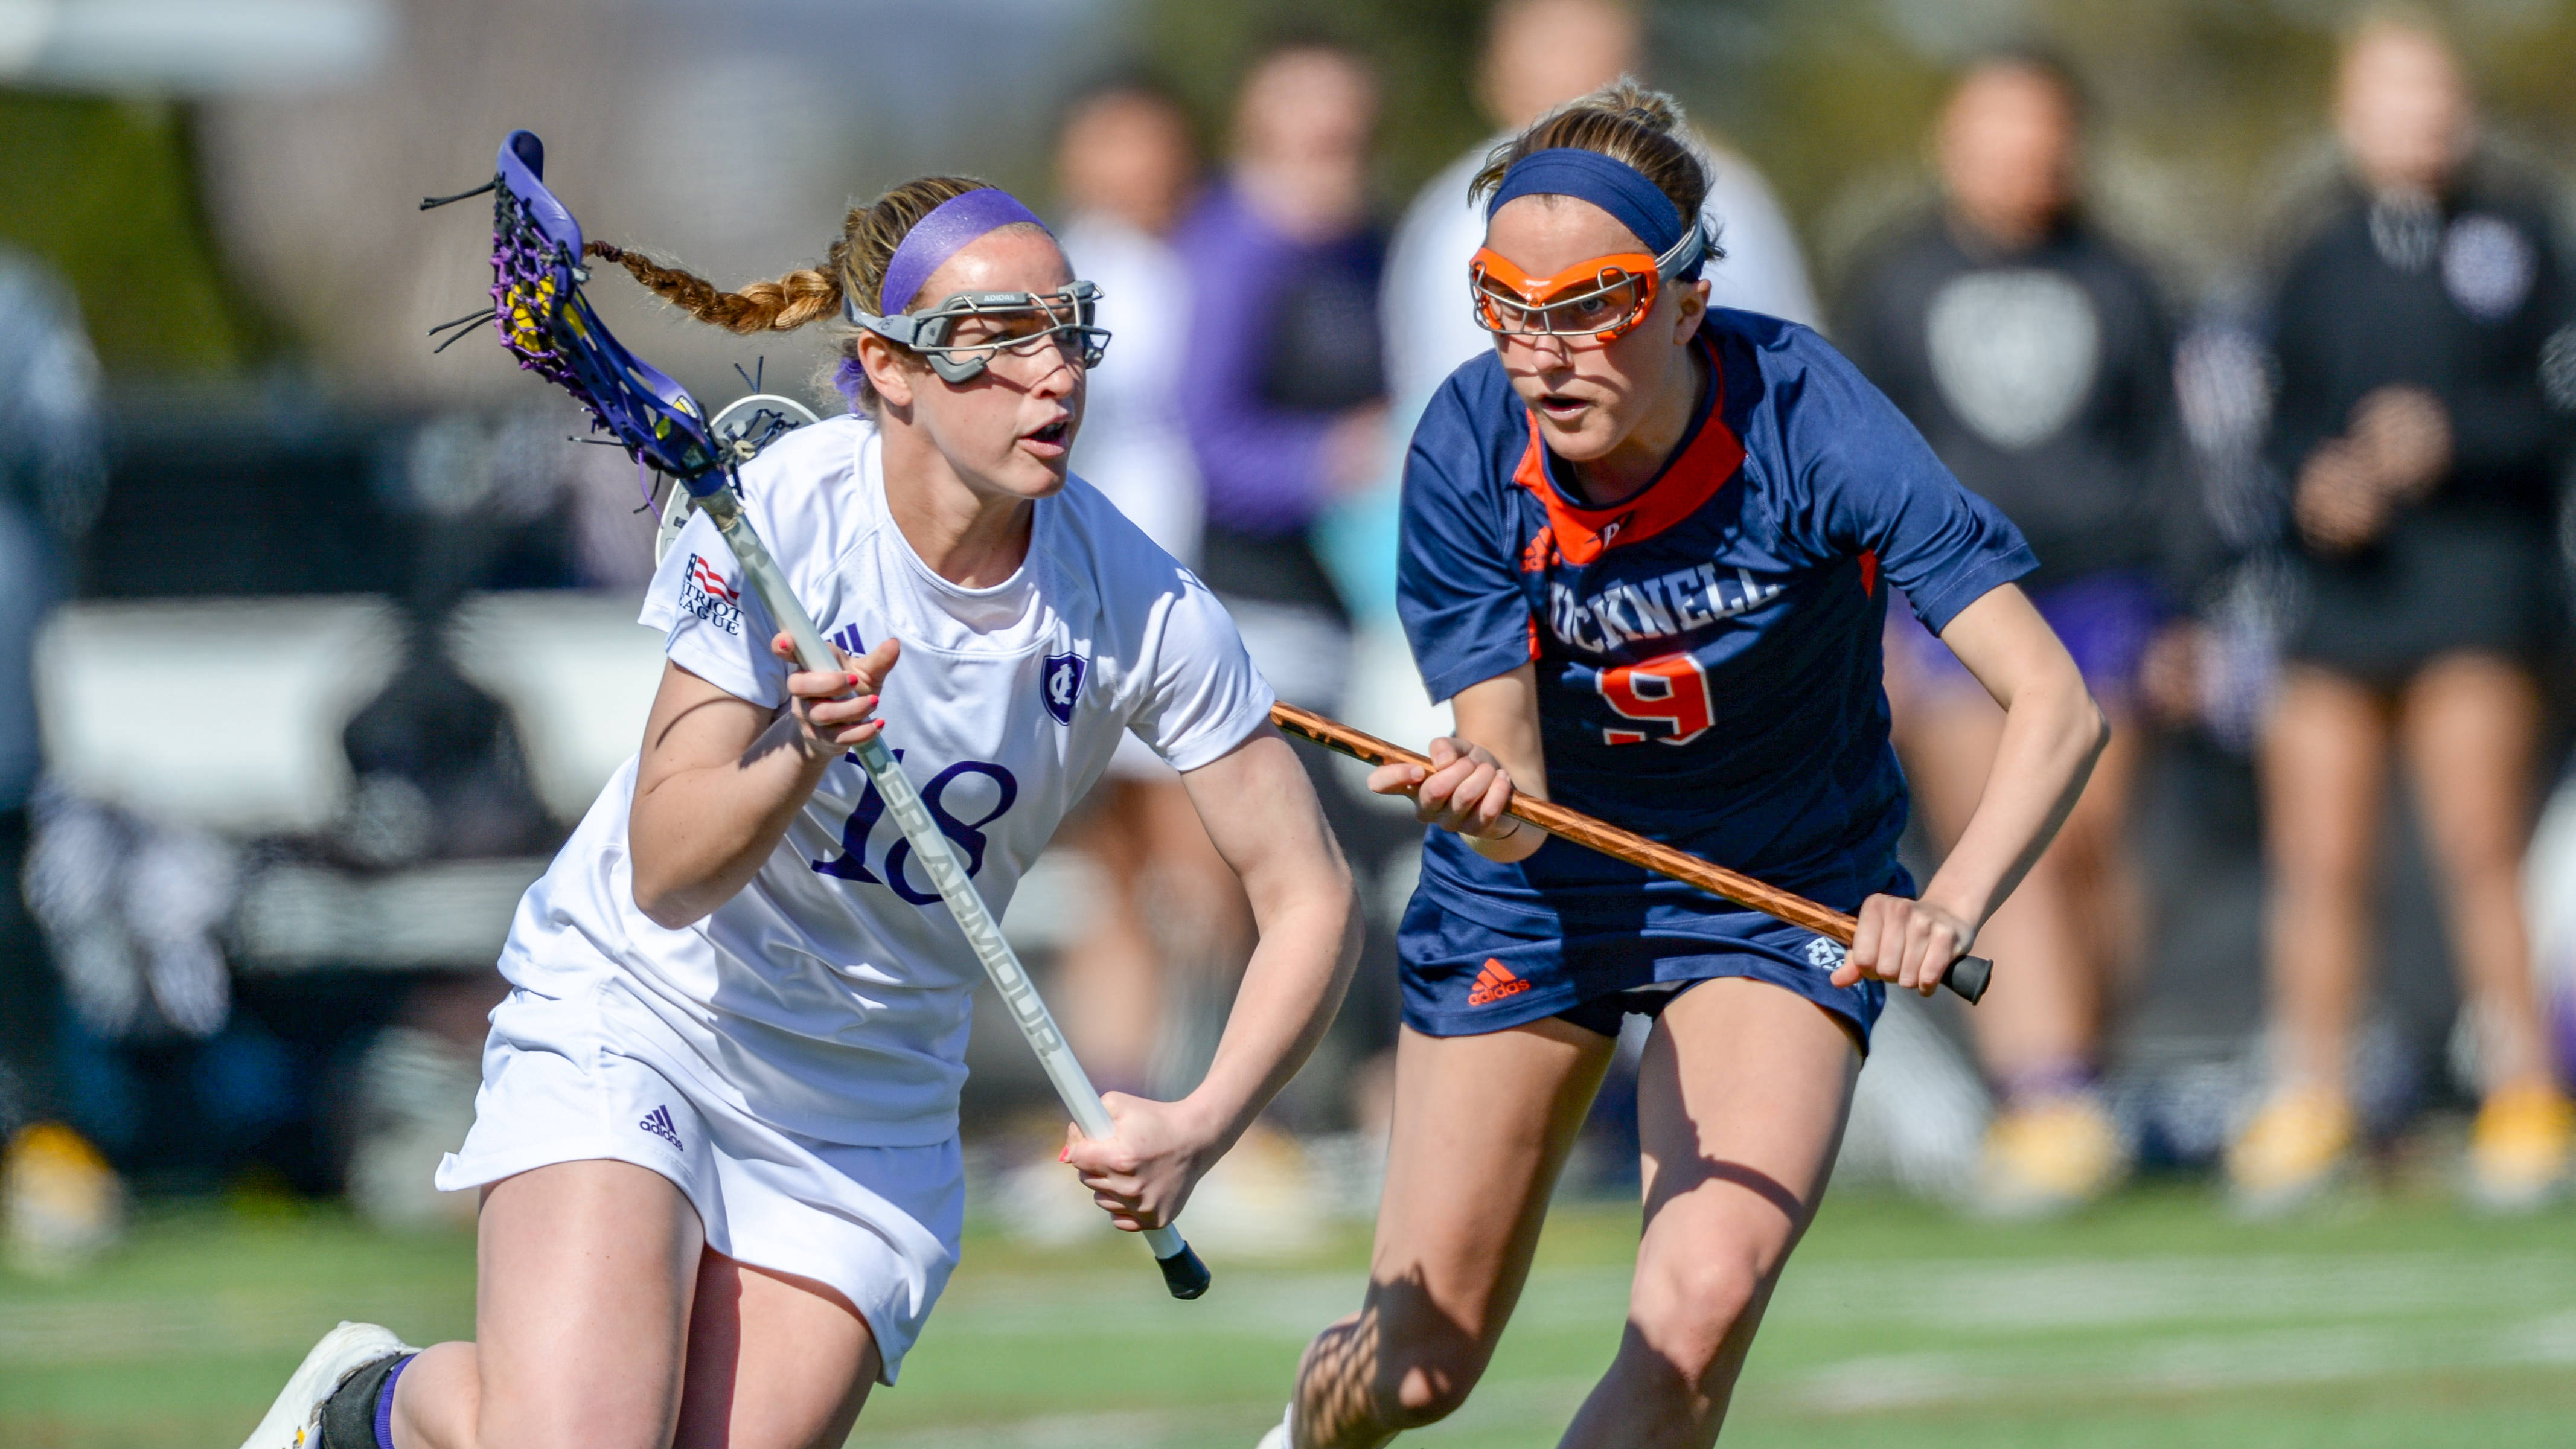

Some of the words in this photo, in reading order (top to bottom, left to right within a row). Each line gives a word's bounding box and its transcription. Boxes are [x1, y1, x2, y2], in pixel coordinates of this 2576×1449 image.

[679, 593, 740, 635] AGUE
[682, 581, 744, 622] TRIOT
[1550, 562, 1781, 653] UCKNELL
[1594, 652, 1715, 746] 9
[811, 749, 1018, 906] 18
[856, 741, 930, 838] DER
[921, 854, 1062, 1058] ARMOUR
[1468, 979, 1530, 1006] adidas
[639, 1121, 683, 1152] adidas
